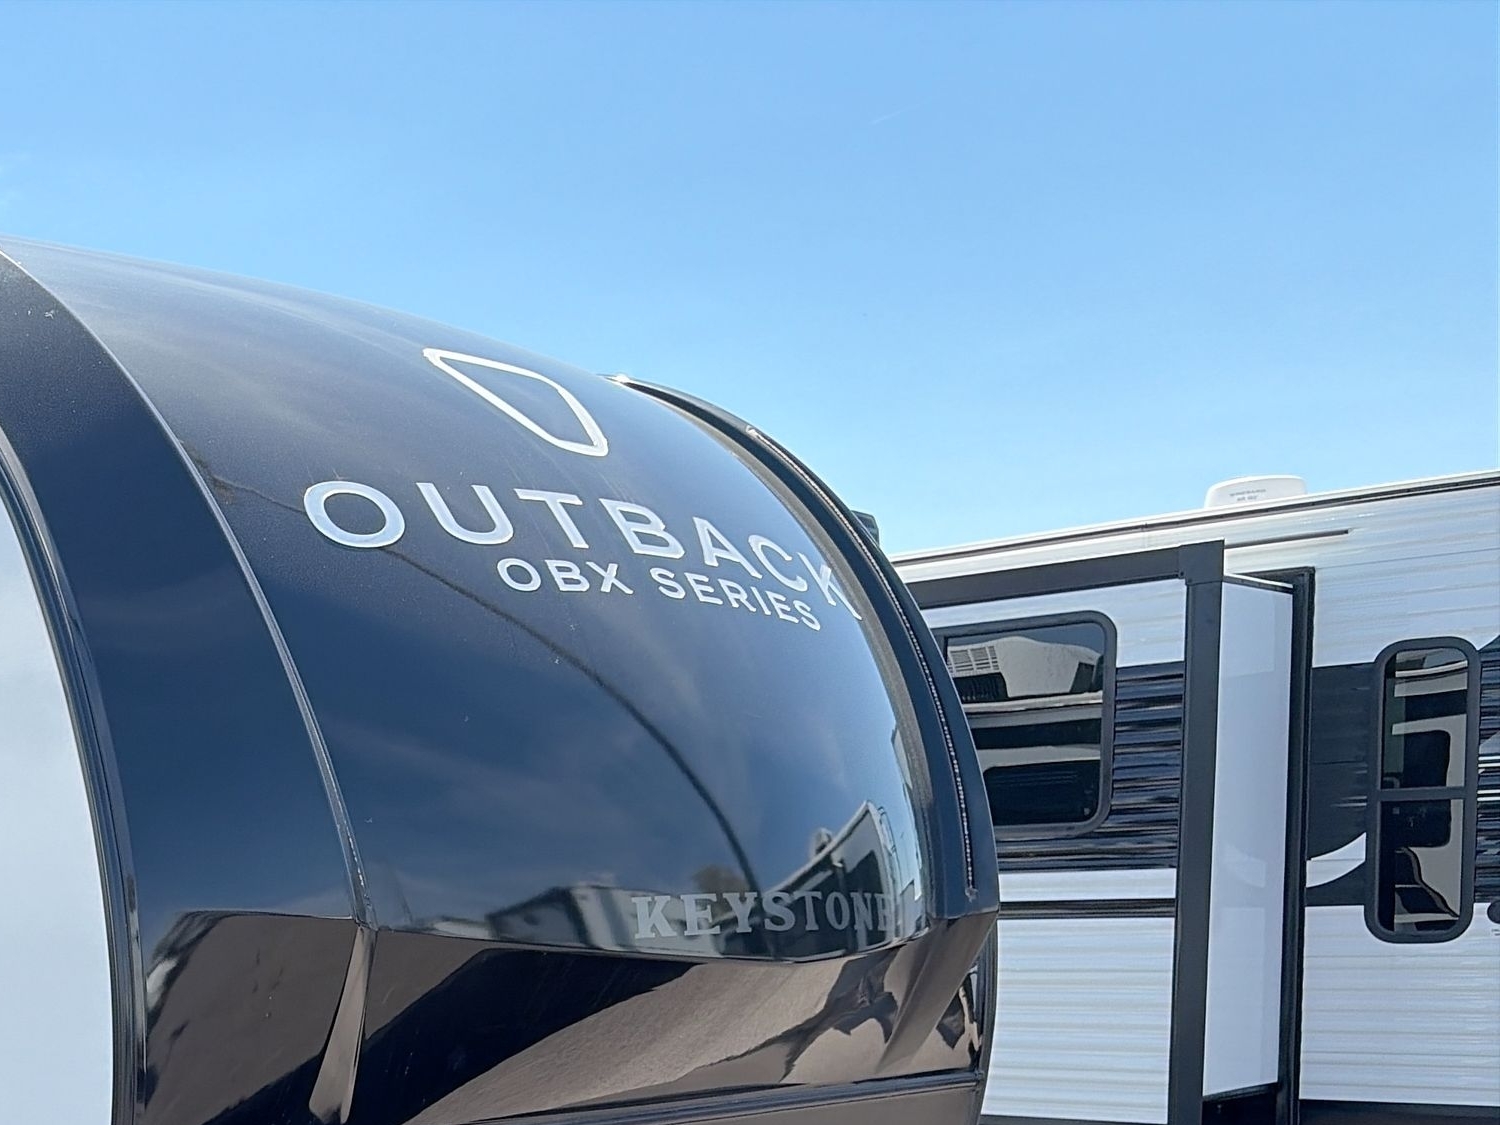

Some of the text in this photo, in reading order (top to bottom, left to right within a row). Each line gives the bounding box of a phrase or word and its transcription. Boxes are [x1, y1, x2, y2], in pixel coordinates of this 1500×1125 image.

[304, 479, 863, 621] OUTBACK
[497, 558, 821, 631] OBX SERIES
